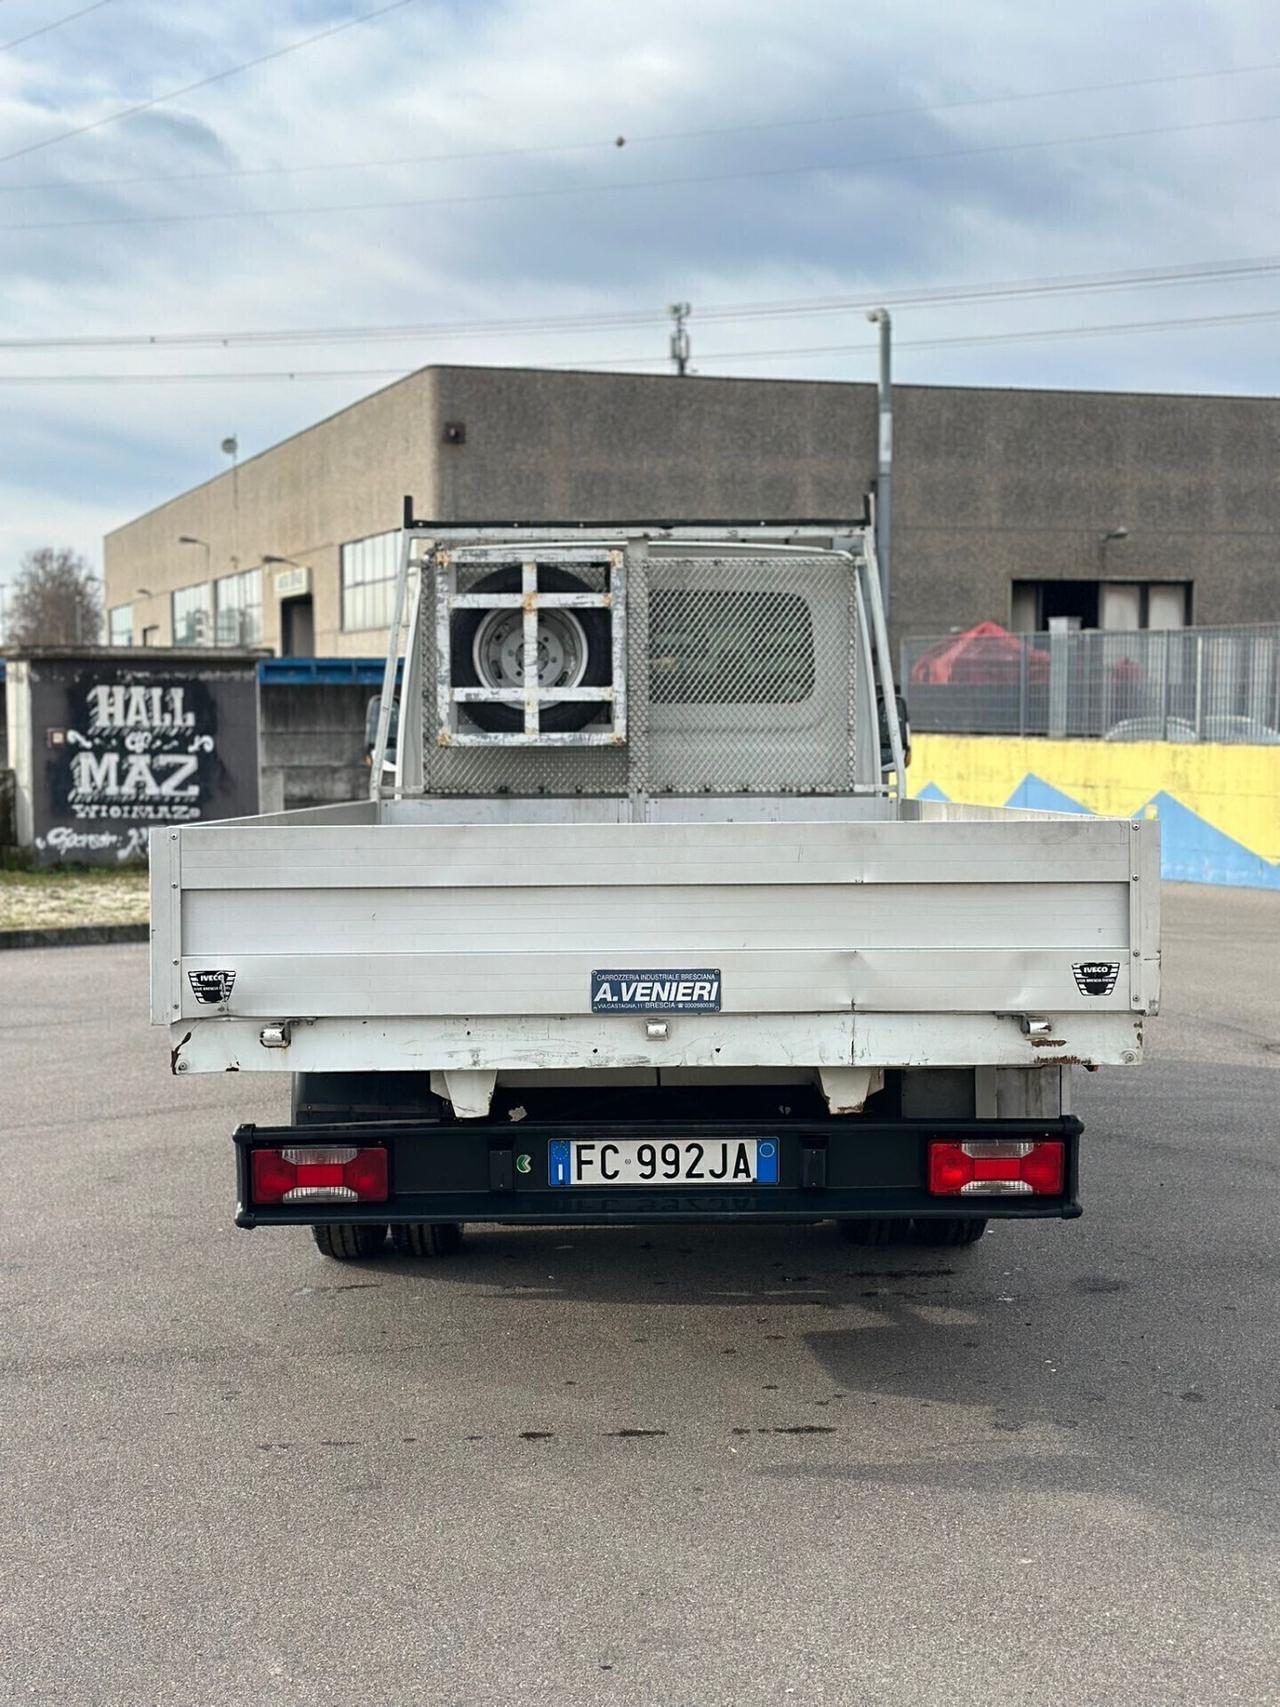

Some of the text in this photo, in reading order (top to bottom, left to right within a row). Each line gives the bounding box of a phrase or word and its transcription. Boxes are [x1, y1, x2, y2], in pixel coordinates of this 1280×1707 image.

[92, 685, 196, 728] HALL
[76, 752, 200, 797] MAZ
[640, 973, 680, 981] INDUSTRIALE
[680, 973, 716, 981] BRESCIANA
[645, 1001, 676, 1009] BRESCIA
[576, 1143, 620, 1181] FC
[636, 1142, 752, 1180] 992JA
